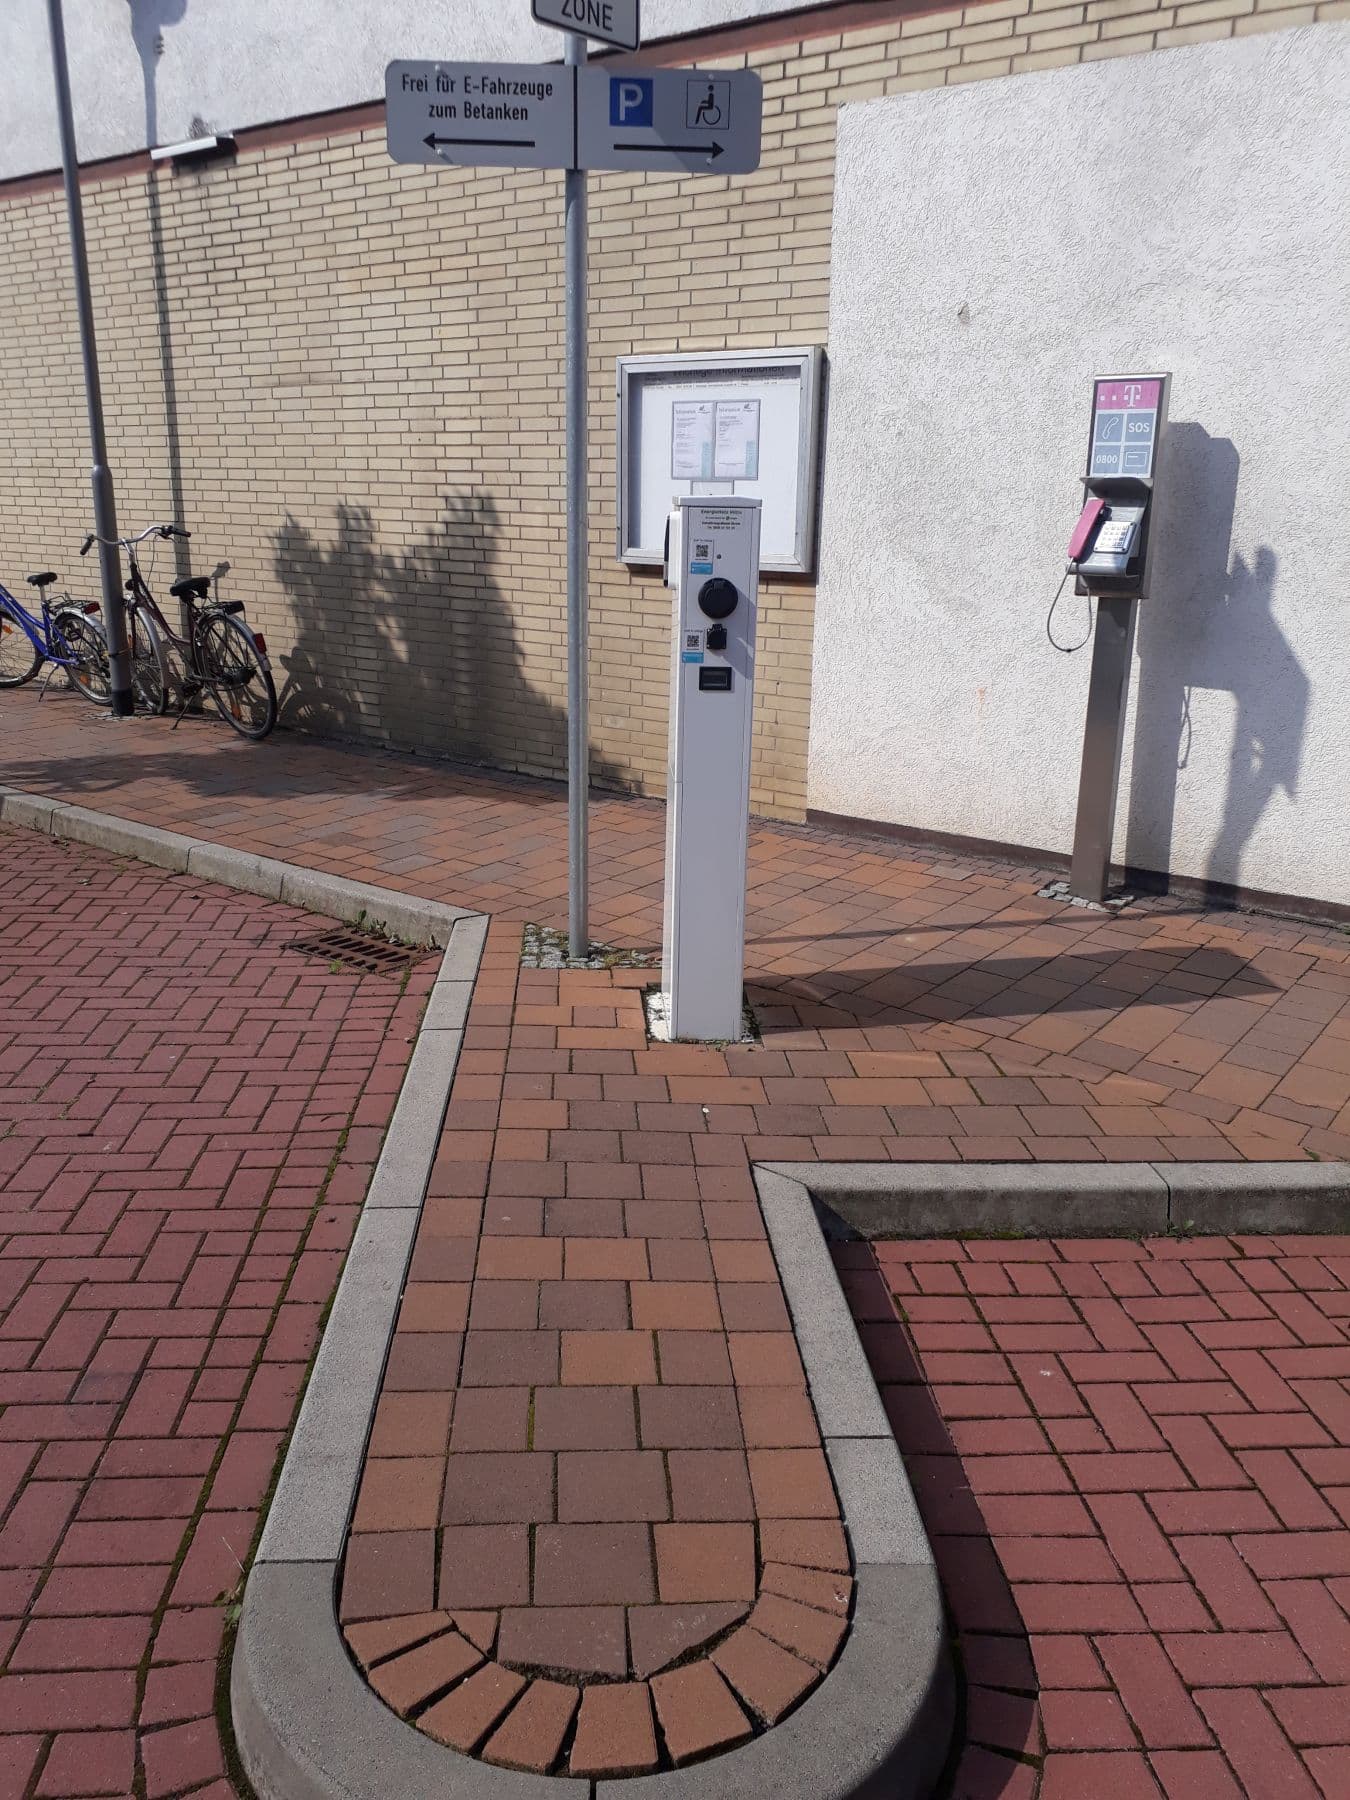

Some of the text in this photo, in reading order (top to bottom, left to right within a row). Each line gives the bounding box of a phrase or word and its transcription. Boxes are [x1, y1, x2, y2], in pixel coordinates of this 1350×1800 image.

[561, 0, 613, 32] ZONE
[401, 74, 554, 101] Frei für E-Fahrzeuge
[428, 102, 529, 121] zum Betanken
[619, 83, 644, 122] P
[1128, 422, 1150, 433] SOS
[1096, 455, 1118, 464] 0800
